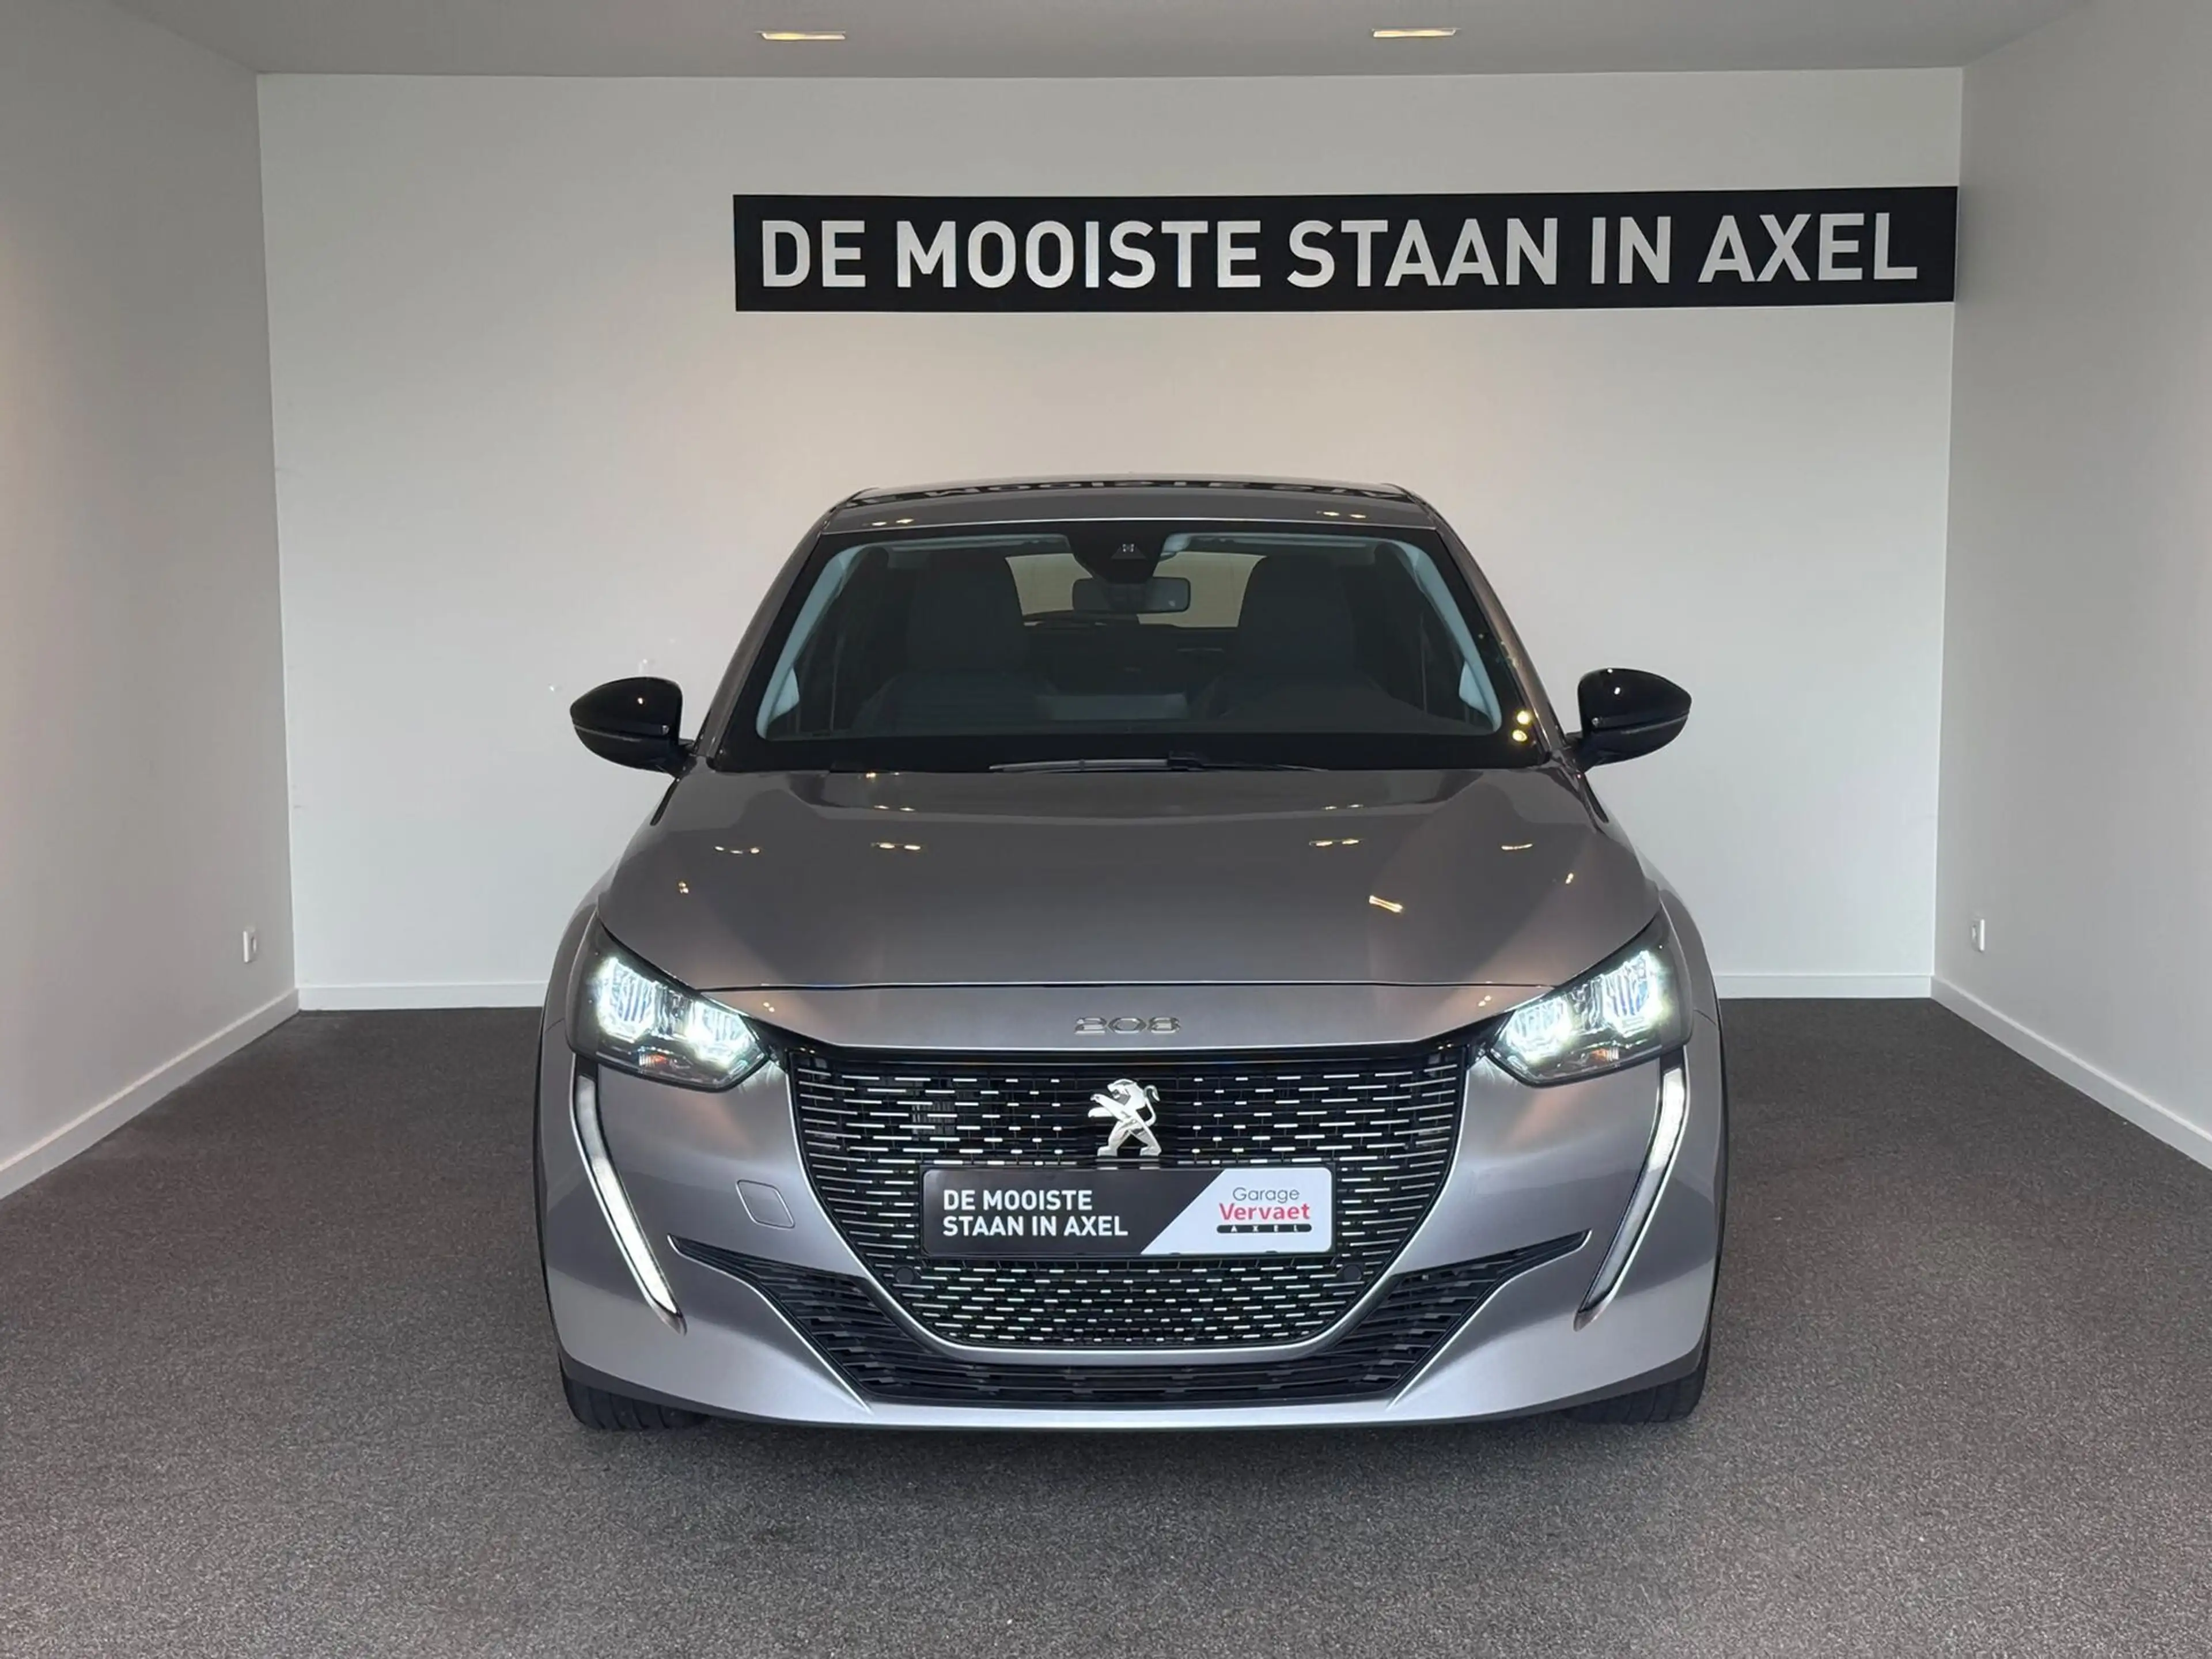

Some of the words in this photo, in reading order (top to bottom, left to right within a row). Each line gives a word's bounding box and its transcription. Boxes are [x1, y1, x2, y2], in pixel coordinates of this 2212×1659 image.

[762, 220, 866, 287] DE
[896, 220, 1261, 289] MOOISTE
[1286, 218, 1558, 288] STAAN
[1591, 216, 1671, 284] IN
[1698, 213, 1918, 283] AXEL
[1074, 1017, 1182, 1035] 208
[943, 1190, 976, 1210] DE
[983, 1190, 1092, 1210] MOOISTE
[1232, 1187, 1300, 1204] Garage
[1218, 1202, 1310, 1220] Vervaet
[943, 1215, 1024, 1236] STAAN
[1032, 1215, 1056, 1236] IN
[1063, 1215, 1128, 1236] AXEL
